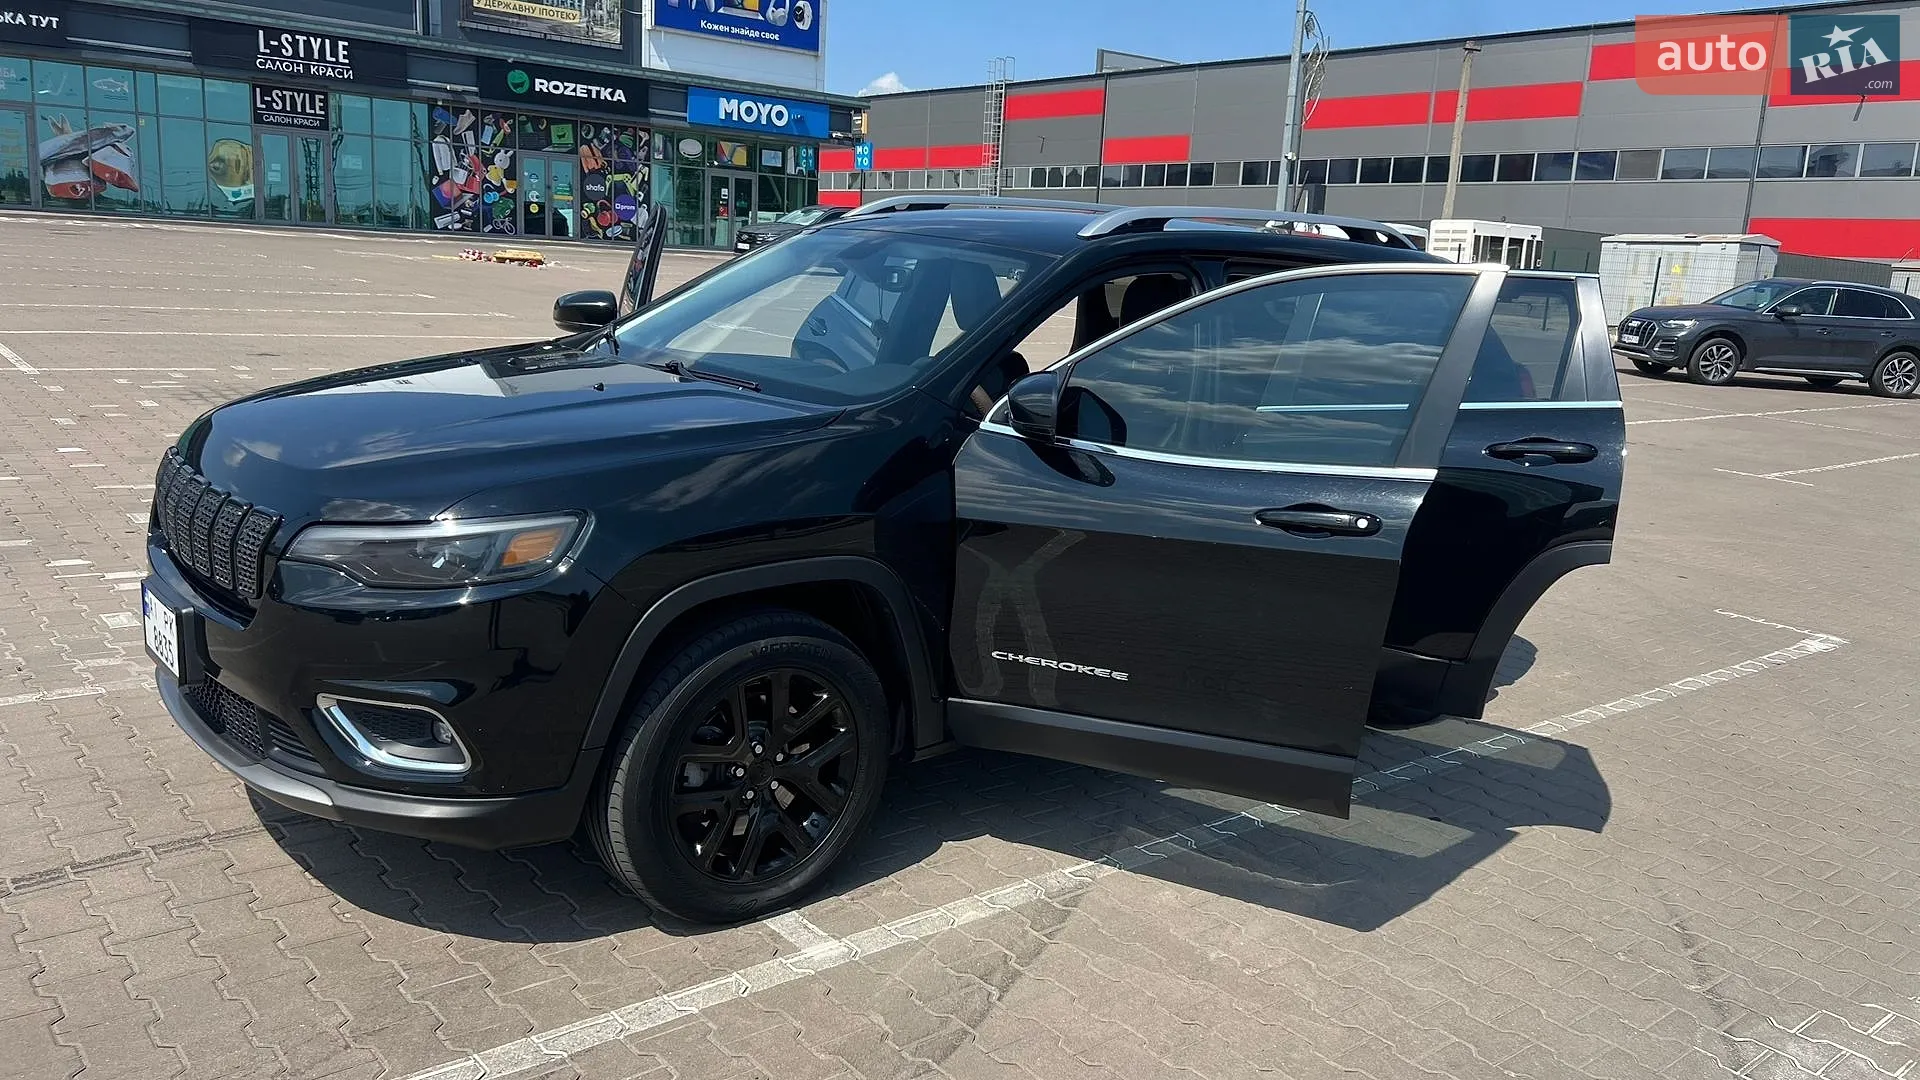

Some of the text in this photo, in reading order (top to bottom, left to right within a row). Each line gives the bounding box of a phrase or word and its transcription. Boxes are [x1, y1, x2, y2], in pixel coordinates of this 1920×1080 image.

[28, 14, 60, 29] ТУТ
[484, 0, 537, 15] ДЕРЖАВНУ
[539, 8, 578, 21] ІПОТЕКУ
[700, 19, 780, 41] Кожен знайде своє
[258, 29, 350, 64] L-STYLE
[256, 58, 354, 80] САЛОН КРАСИ
[255, 87, 326, 115] L-STYLE
[534, 78, 627, 103] ROZETKA
[263, 114, 320, 127] САЛОН КРАСИ
[718, 97, 789, 127] MOYO
[856, 145, 869, 155] MO
[856, 157, 869, 166] YO
[586, 183, 605, 192] shafa
[154, 624, 174, 668] 8835
[991, 650, 1129, 681] CHEROKEE
